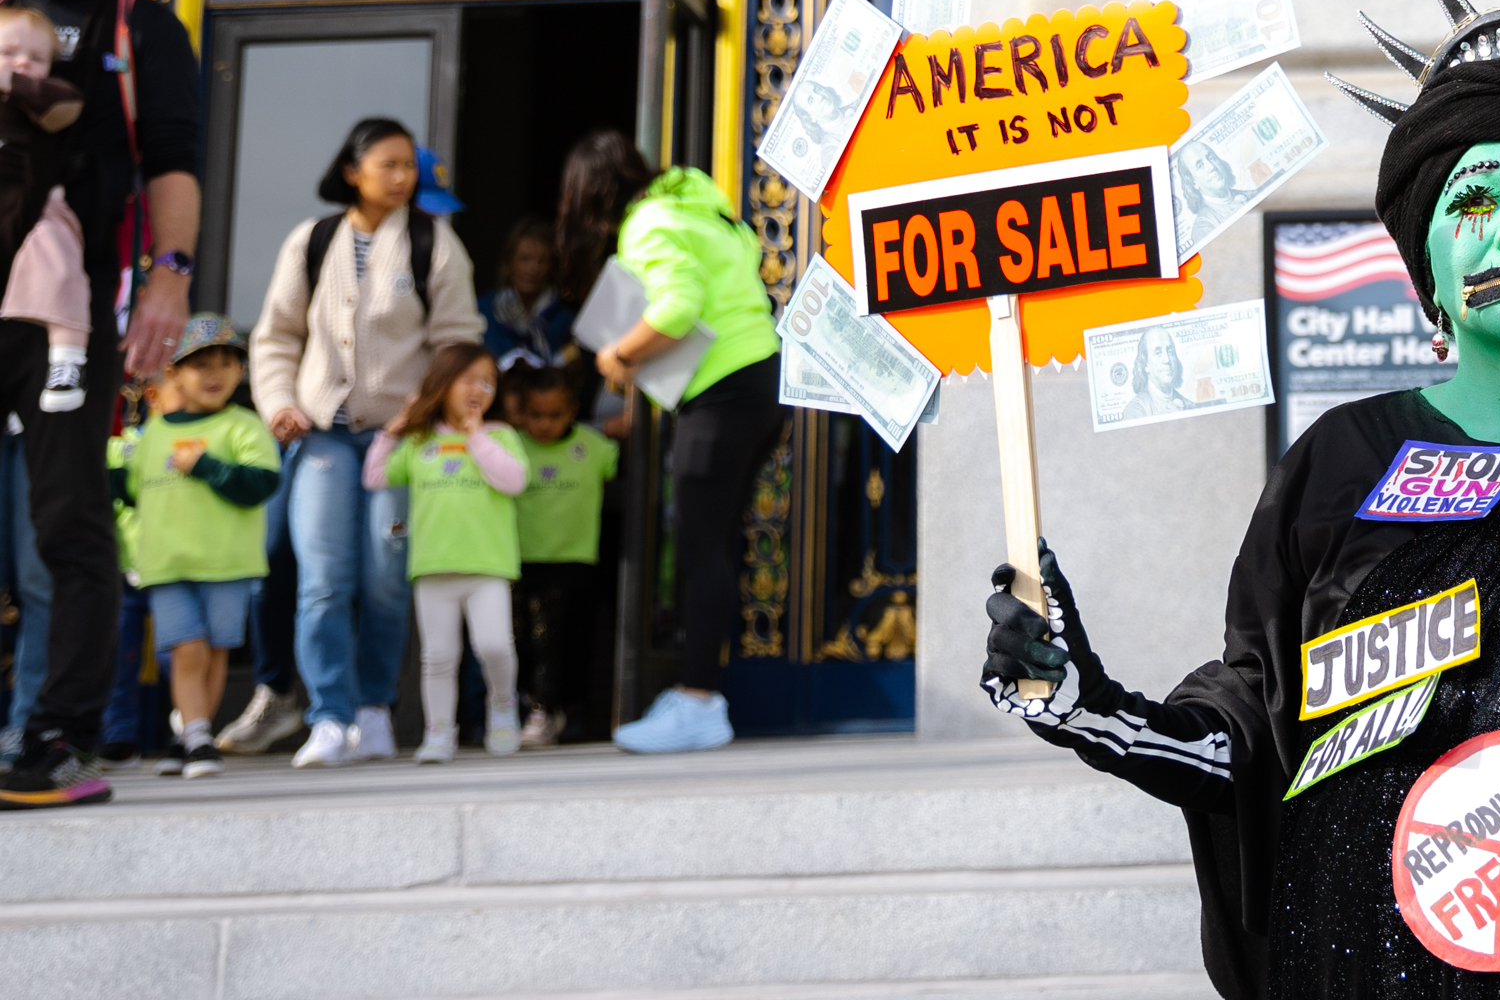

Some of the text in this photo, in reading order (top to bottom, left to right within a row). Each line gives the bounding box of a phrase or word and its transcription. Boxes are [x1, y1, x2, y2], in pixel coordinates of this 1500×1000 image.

[885, 16, 1160, 120] AMERICA
[946, 92, 1124, 156] IT IS NOT
[872, 183, 1148, 302] FOR SALE
[1089, 332, 1115, 346] 100
[1286, 304, 1350, 343] City
[1351, 302, 1416, 335] Hall
[1286, 337, 1389, 368] Center
[1229, 381, 1262, 398] 100
[1100, 411, 1124, 423] 100
[1374, 492, 1495, 513] VIOLENCE
[1399, 476, 1500, 498] GUN
[1306, 583, 1479, 708] JUSTICE
[1293, 716, 1359, 791] FOR
